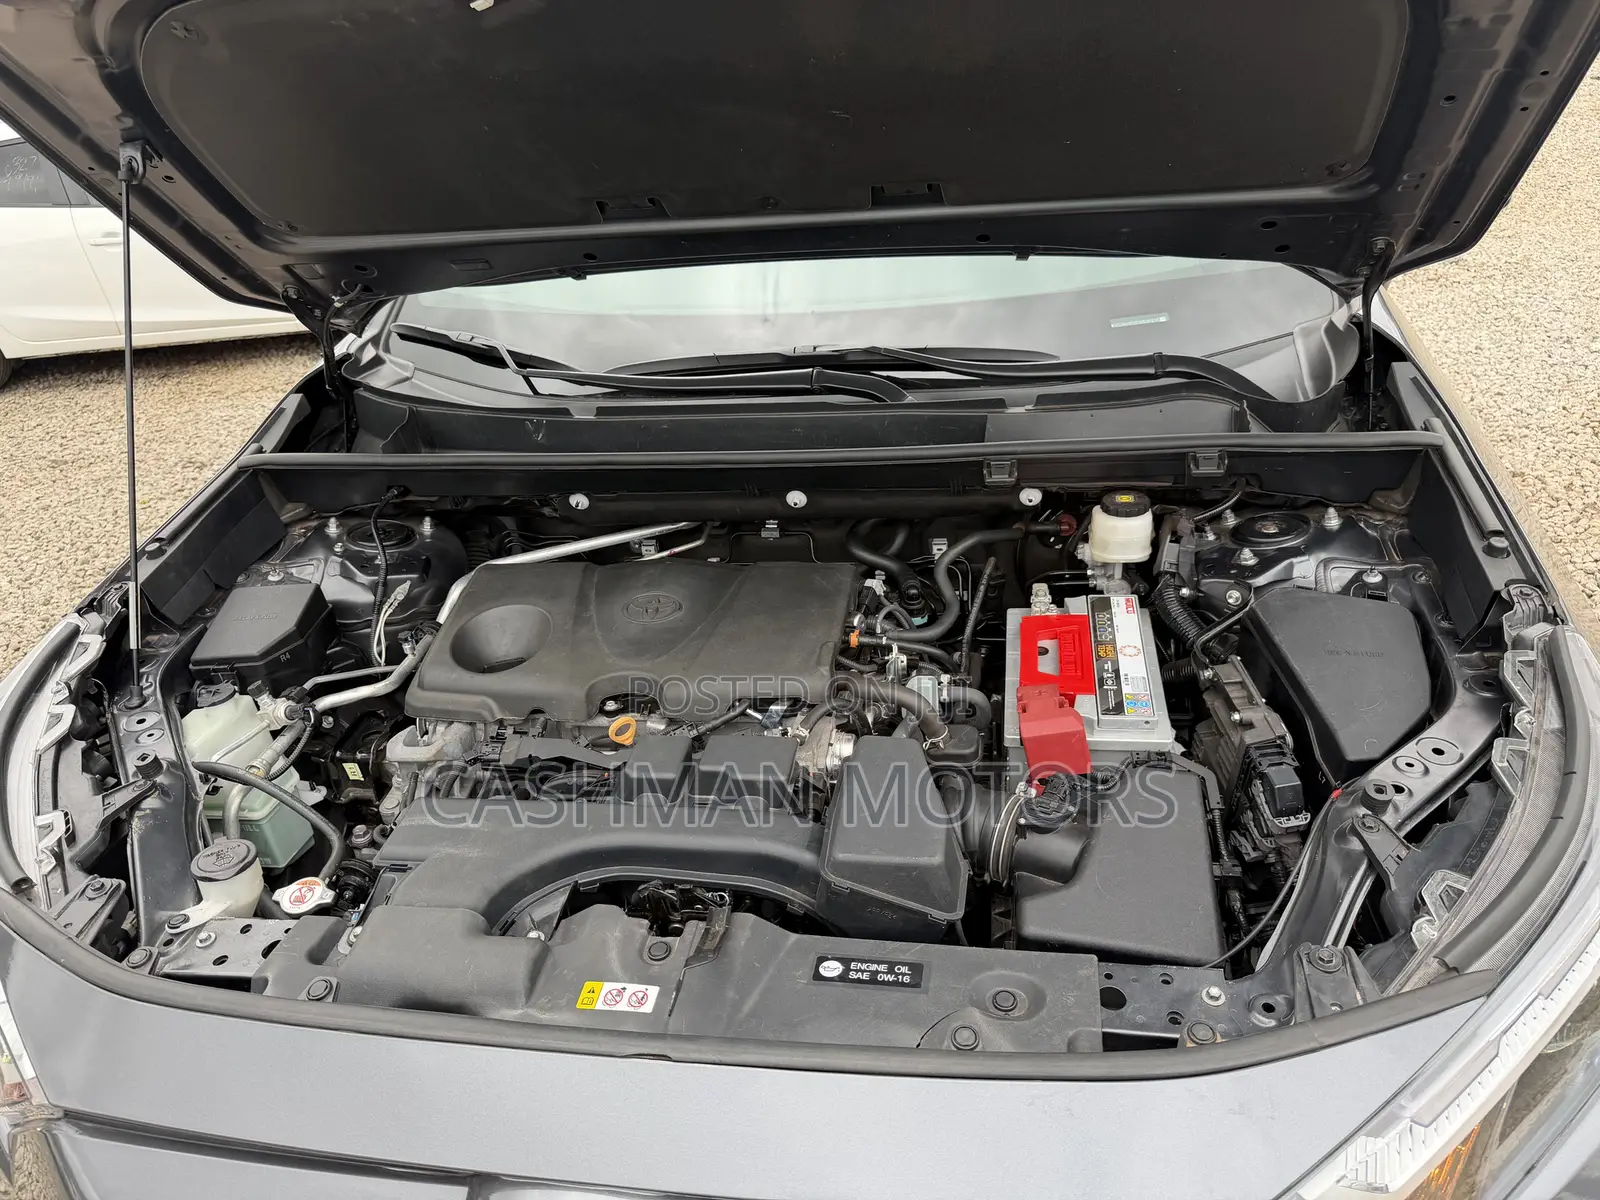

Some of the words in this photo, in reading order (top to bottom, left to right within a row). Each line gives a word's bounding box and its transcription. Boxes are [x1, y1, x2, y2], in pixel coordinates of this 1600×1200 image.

[279, 652, 291, 663] R4
[850, 961, 888, 972] ENGINE
[894, 965, 912, 974] OIL
[848, 972, 870, 980] SAE
[877, 973, 911, 983] 0W-16
